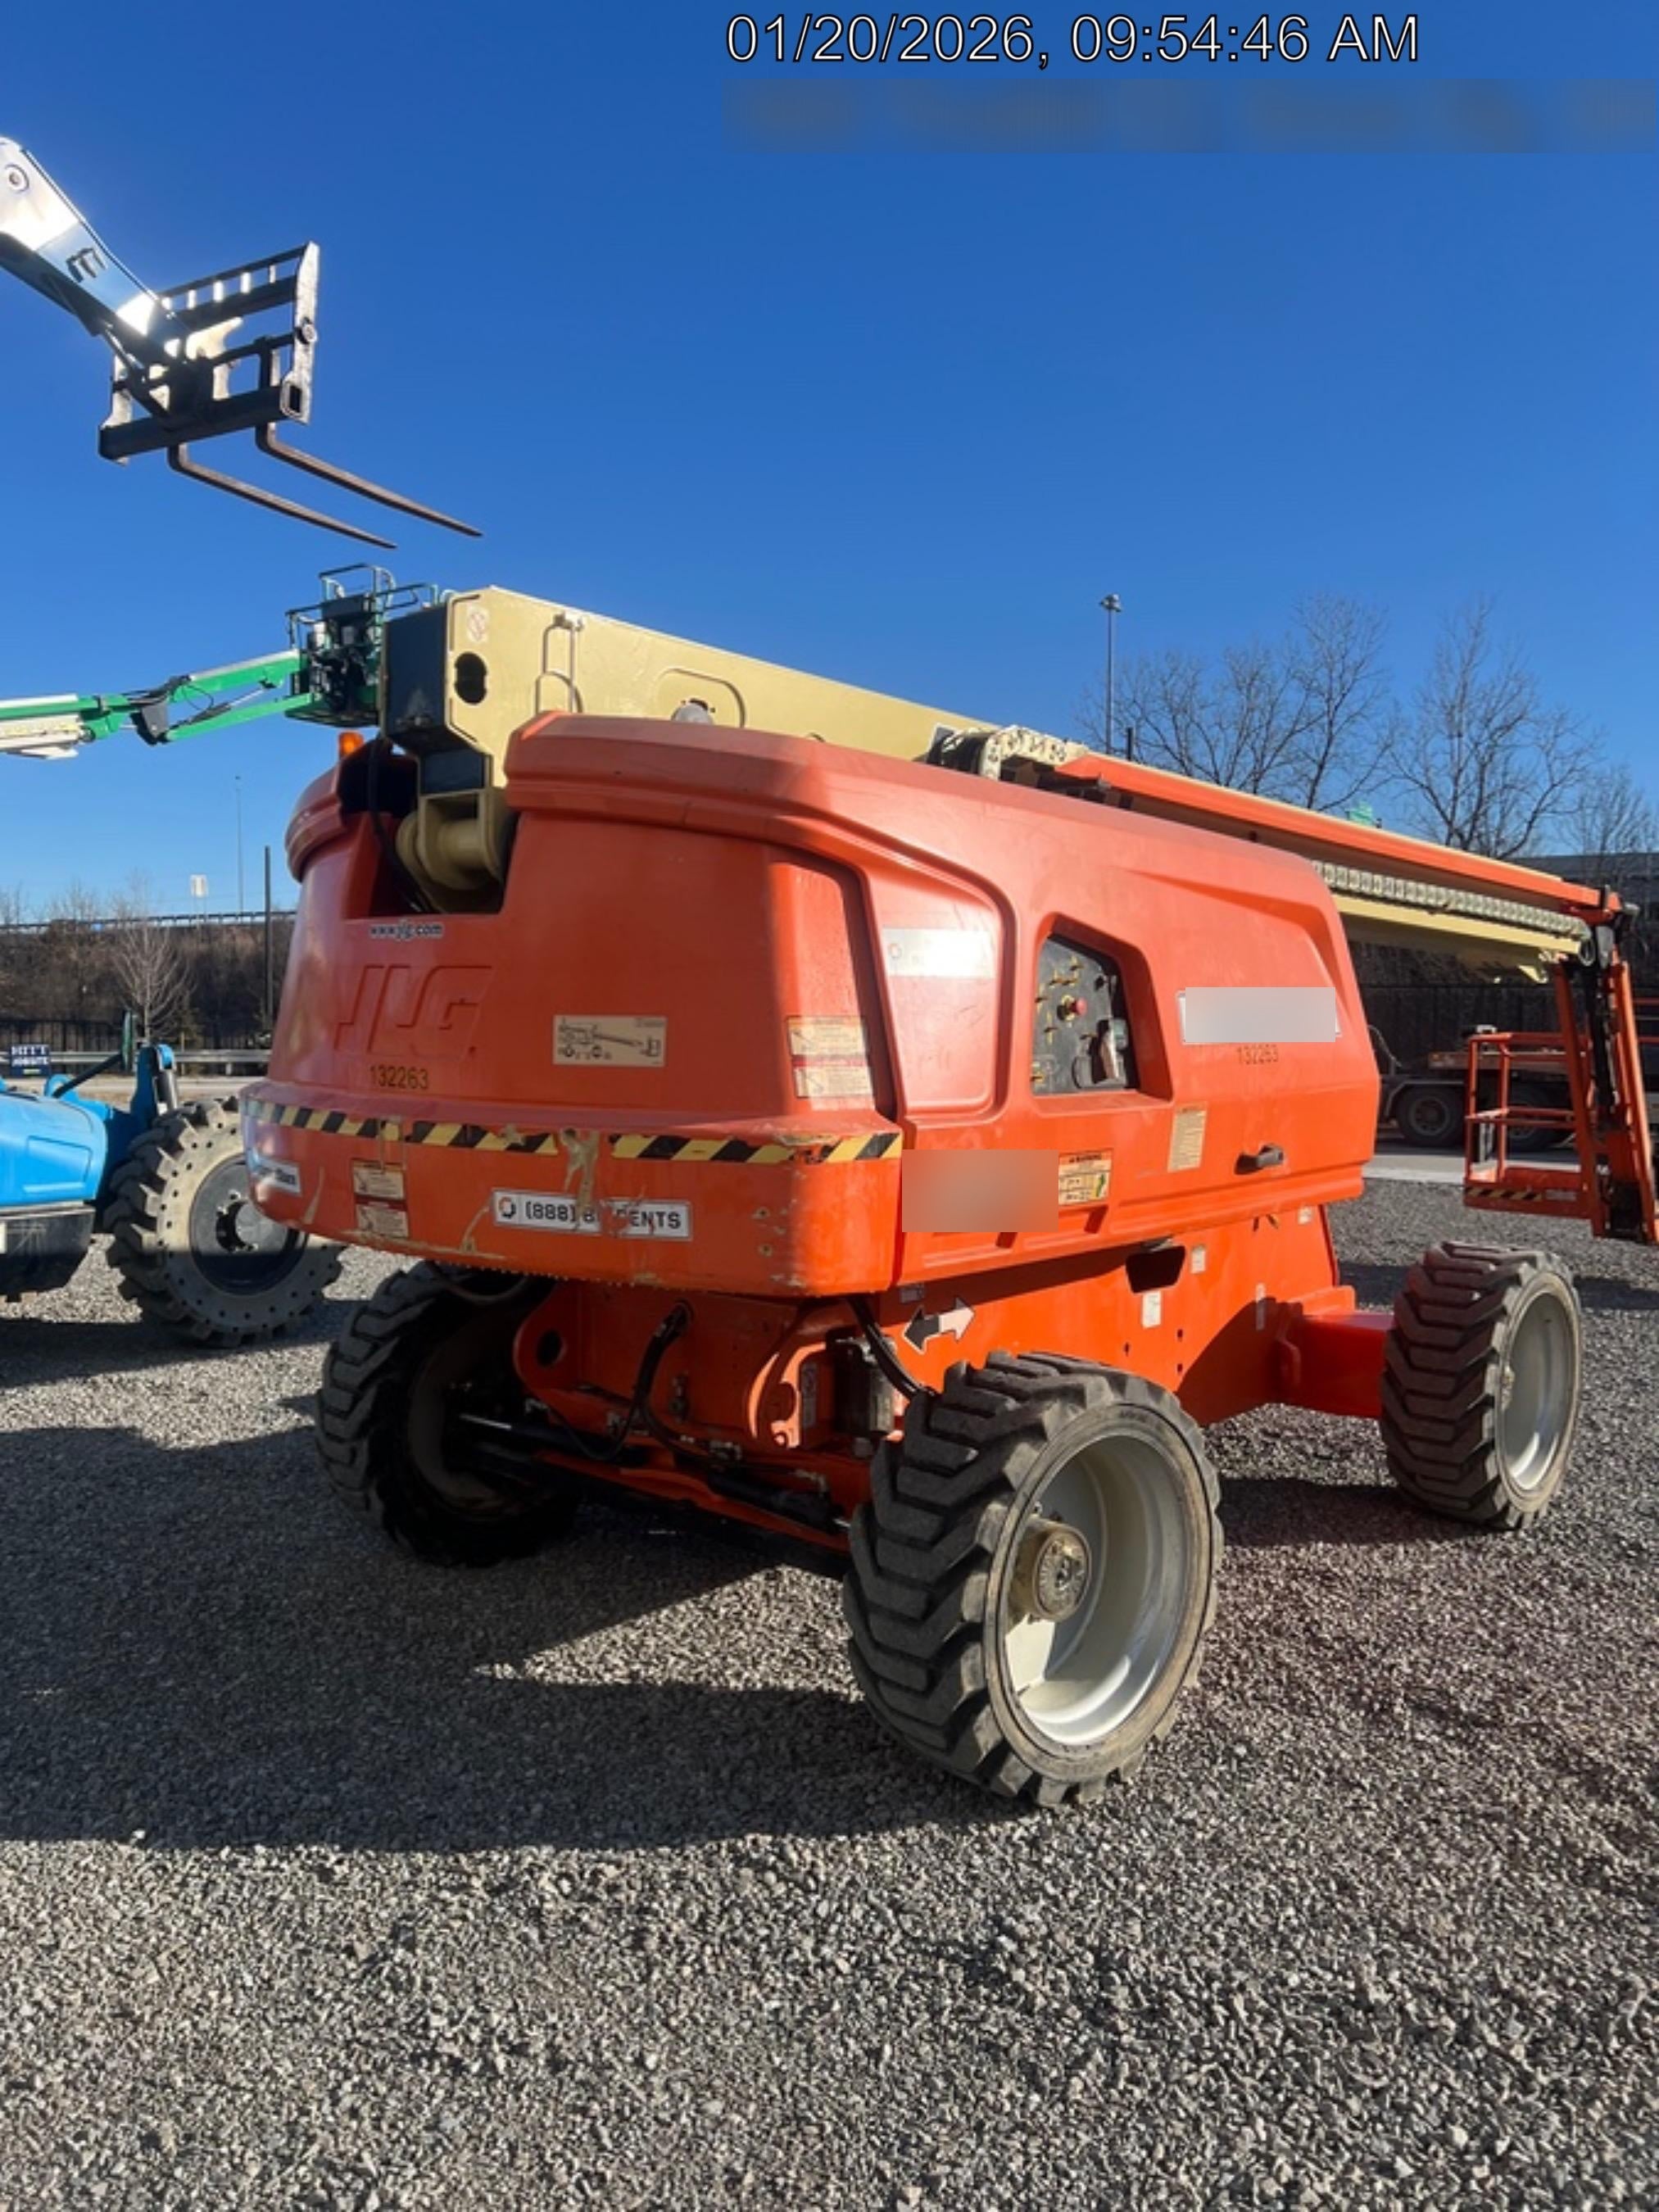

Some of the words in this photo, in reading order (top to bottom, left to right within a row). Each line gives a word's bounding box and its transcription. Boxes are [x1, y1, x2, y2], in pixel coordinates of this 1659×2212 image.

[333, 963, 493, 1058] JLG
[369, 1064, 429, 1089] 132263
[525, 1200, 577, 1222] (888)
